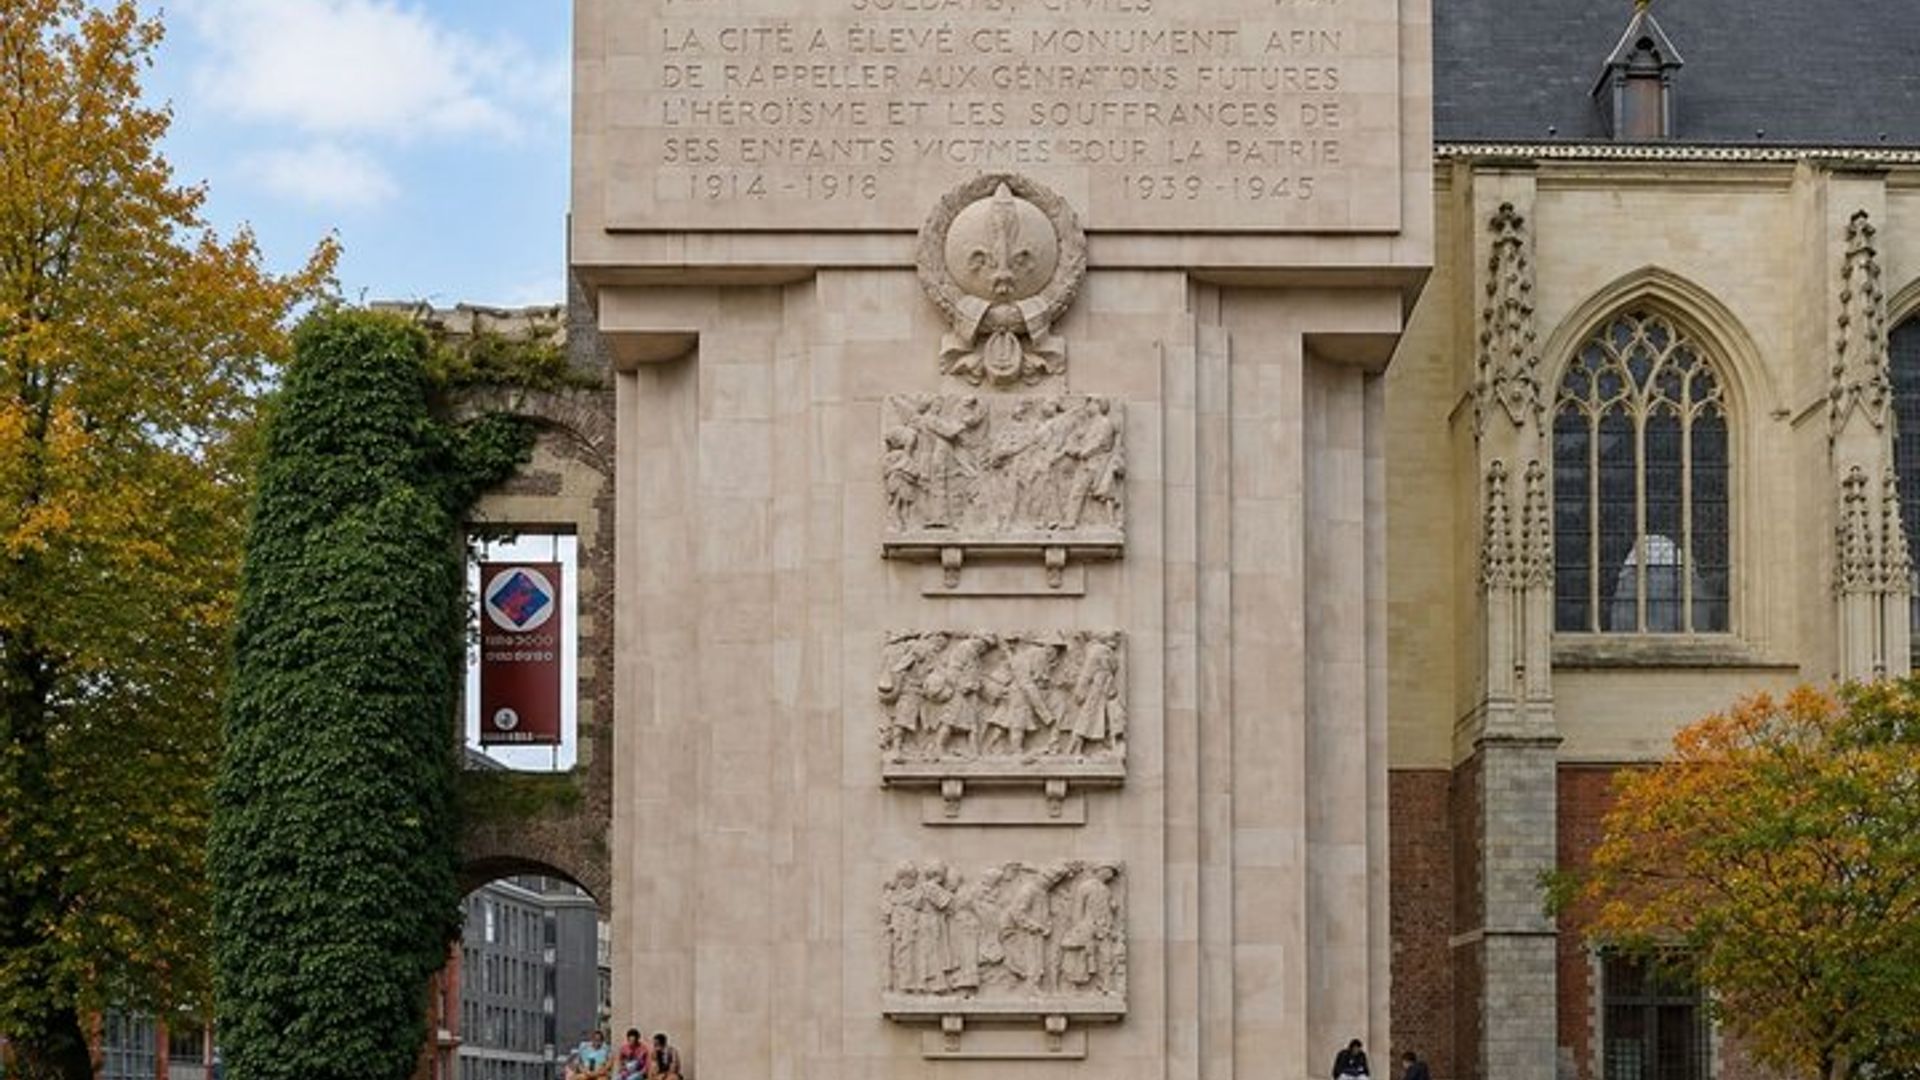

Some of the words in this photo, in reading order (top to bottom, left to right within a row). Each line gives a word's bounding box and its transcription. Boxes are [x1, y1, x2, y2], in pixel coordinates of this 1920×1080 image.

[662, 28, 703, 53] LA
[718, 22, 794, 53] CITÉ
[848, 22, 954, 53] ÉLEVÉ
[971, 29, 1013, 54] CE
[1031, 30, 1238, 55] MONUMENT
[1264, 30, 1343, 55] AFIN
[662, 65, 703, 88] DE
[724, 65, 899, 89] RAPPELLER
[915, 66, 977, 89] AUX
[1197, 67, 1340, 91] FUTURES
[887, 102, 928, 126] ET
[948, 102, 1005, 126] LES
[1029, 103, 1279, 127] SOUFFRANCES
[1300, 103, 1341, 127] DE
[663, 138, 720, 163] SES
[741, 138, 896, 163] ENFANTS
[1068, 140, 1148, 164] POUR
[1168, 140, 1205, 164] LA
[1226, 140, 1341, 164] PATRIE
